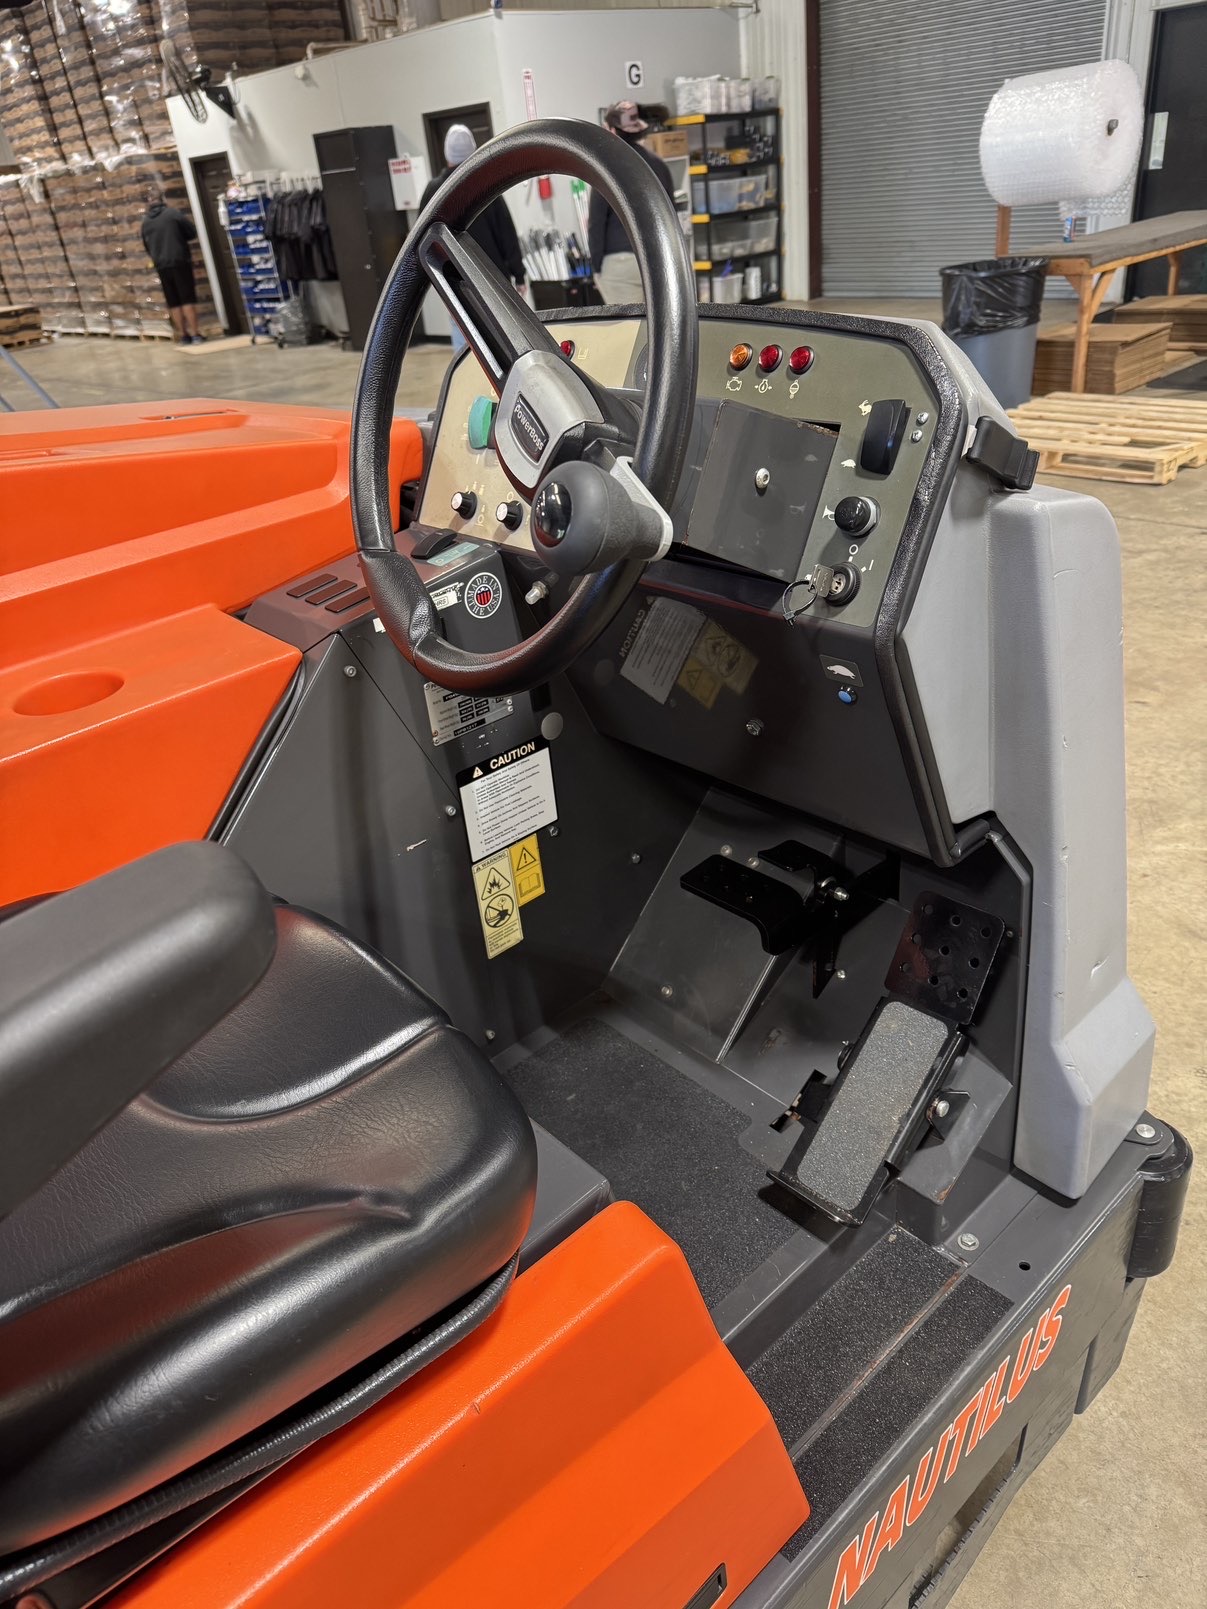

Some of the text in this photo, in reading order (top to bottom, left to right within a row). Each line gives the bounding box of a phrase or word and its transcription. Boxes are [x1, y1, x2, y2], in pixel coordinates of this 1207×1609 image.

[628, 63, 641, 86] G
[467, 575, 488, 601] MADE
[489, 579, 499, 590] IN
[468, 600, 485, 616] THE
[489, 741, 536, 770] CAUTION
[481, 851, 507, 869] WARNING
[828, 1284, 1072, 1609] NAUTILUS
